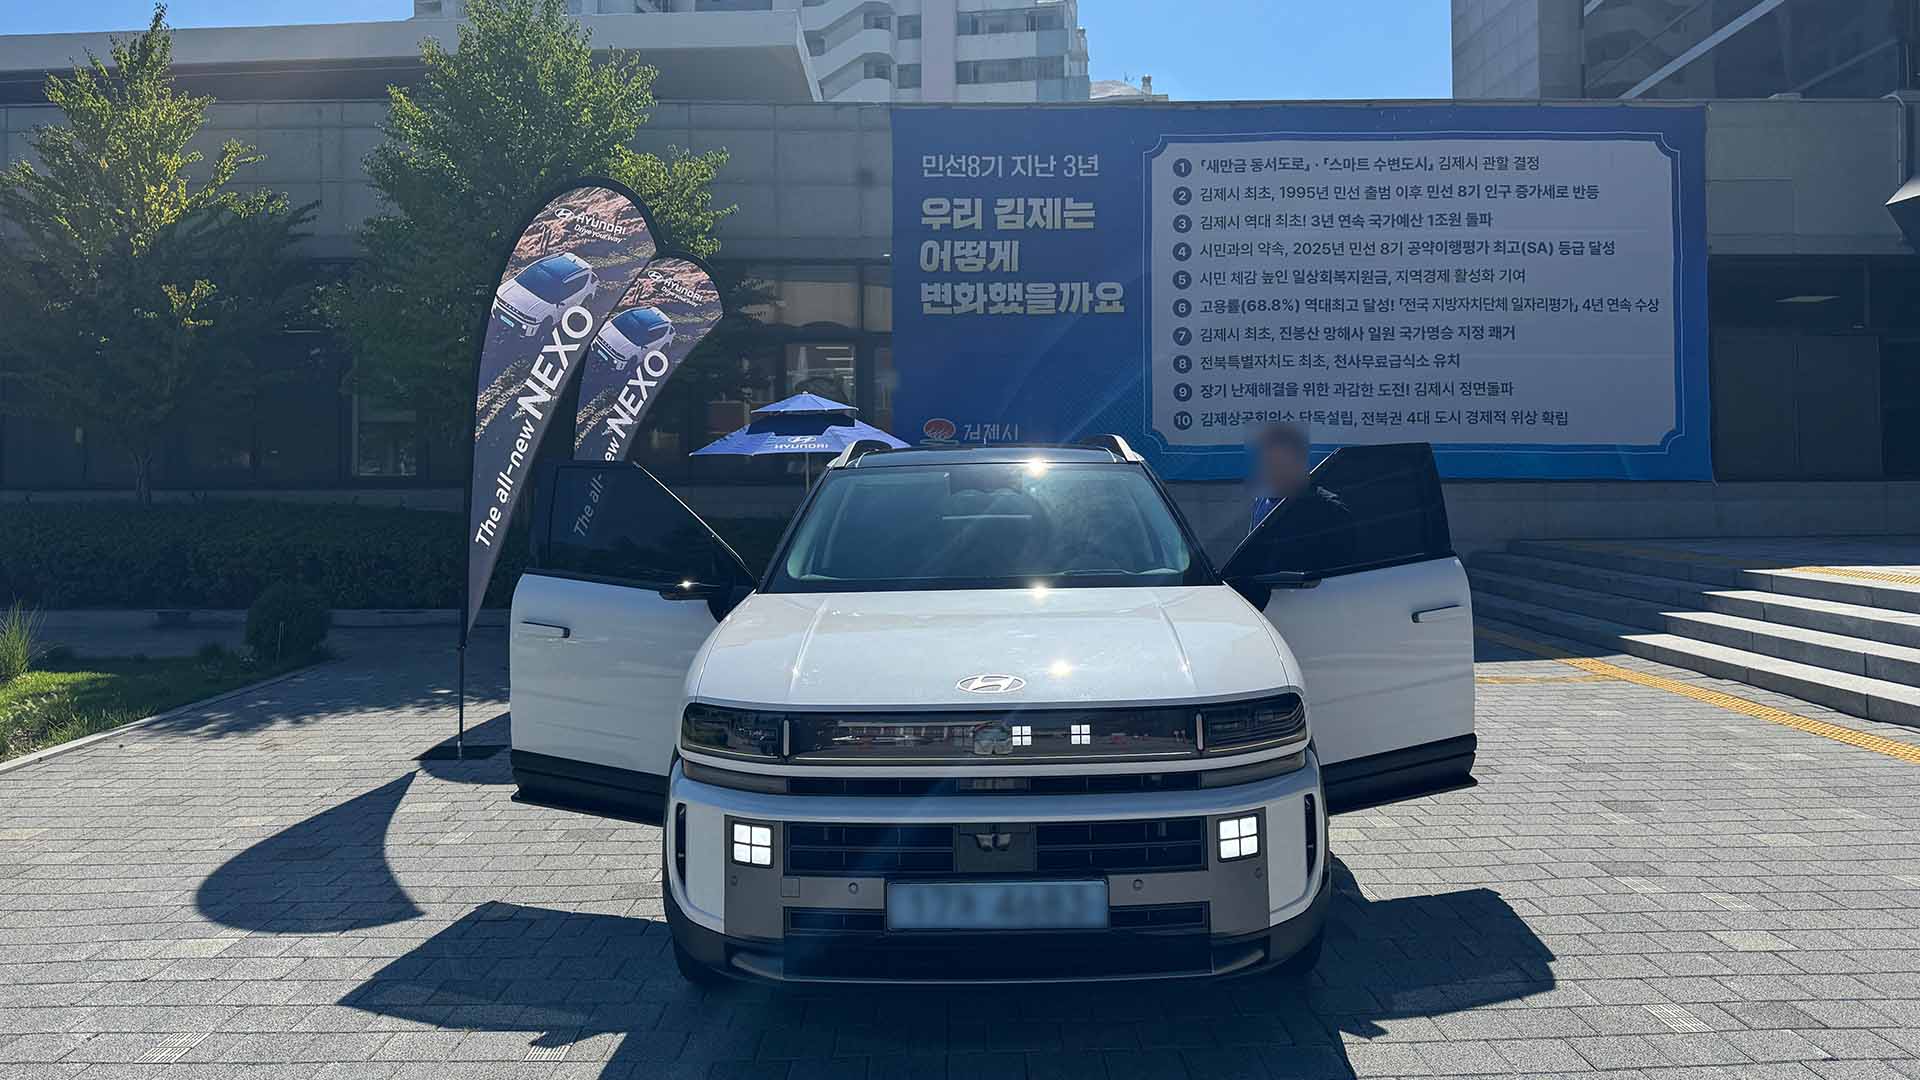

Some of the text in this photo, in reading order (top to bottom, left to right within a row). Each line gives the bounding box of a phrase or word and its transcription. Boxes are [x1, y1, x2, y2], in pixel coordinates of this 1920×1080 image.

[922, 154, 1100, 178] 민선8기 지난 3년
[1439, 156, 1478, 171] 김제시
[1482, 156, 1509, 171] 관할
[1513, 156, 1540, 171] 결정
[1200, 186, 1240, 202] 김제시
[1244, 185, 1275, 202] 최초,
[1279, 185, 1329, 200] 1995년
[1334, 185, 1361, 200] 민선
[1364, 185, 1391, 200] 출범
[1395, 184, 1423, 200] 이후
[1426, 184, 1453, 200] 민선
[1457, 184, 1481, 200] 8기
[1485, 184, 1512, 200] 인구
[1515, 184, 1569, 200] 증가세로
[1572, 184, 1600, 200] 반등
[576, 211, 626, 235] HYUNDAI
[921, 197, 1096, 230] 우리 김제는
[1200, 214, 1240, 230] 김제시
[1244, 214, 1271, 230] 역대
[1275, 213, 1307, 229] 최초!
[1311, 214, 1335, 229] 3년
[1338, 213, 1365, 229] 연속
[1368, 213, 1423, 229] 국가예산
[1427, 213, 1462, 228] 1조원
[1465, 212, 1494, 228] 돌파
[919, 240, 1020, 272] 어떻게
[1200, 242, 1254, 258] 시민과의
[1257, 242, 1289, 258] 약속,
[1293, 241, 1345, 257] 2025년
[1349, 241, 1376, 257] 민선
[1380, 241, 1403, 257] 8기
[1407, 240, 1490, 256] 공약이행평가
[1493, 240, 1554, 257] 최고(SA)
[1558, 240, 1586, 256] 등급
[1589, 240, 1616, 256] 달성
[1200, 271, 1226, 286] 시민
[1230, 270, 1257, 286] 체감
[1261, 270, 1288, 286] 높인
[1292, 269, 1393, 287] 일상회복지원금,
[1396, 268, 1450, 285] 지역경제
[1454, 268, 1495, 284] 활성화
[1499, 268, 1526, 285] 기여
[920, 281, 1125, 315] 변화했을까요
[1200, 298, 1300, 315] 고용률(68.8%)
[1305, 298, 1359, 313] 역대최고
[1363, 298, 1395, 313] 달성!
[1432, 296, 1509, 312] 지방자치단체
[1582, 297, 1604, 313] 4년
[1607, 297, 1633, 313] 연속
[1635, 297, 1660, 313] 수상
[1200, 327, 1240, 343] 김제시
[1244, 326, 1275, 342] 최초,
[1279, 326, 1320, 342] 진봉산
[1323, 326, 1365, 342] 망해사
[1368, 326, 1396, 342] 일원
[1400, 325, 1455, 341] 국가명승
[1458, 325, 1485, 341] 지정
[1200, 355, 1296, 371] 전북특별자치도
[1299, 354, 1330, 371] 최초,
[1334, 354, 1430, 370] 천사무료급식소
[1433, 353, 1460, 369] 유치
[1201, 383, 1227, 399] 장기
[1231, 382, 1298, 398] 난제해결을
[1302, 382, 1329, 398] 위한
[1333, 382, 1374, 398] 과감한
[1377, 382, 1410, 397] 도전!
[1415, 381, 1455, 397] 김제시
[1459, 381, 1514, 397] 정면돌파
[475, 305, 593, 547] The all-new NEXO
[1361, 410, 1402, 427] 전북권
[1406, 411, 1430, 426] 4대
[1434, 410, 1461, 425] 도시
[1465, 410, 1508, 426] 경제적
[1511, 410, 1538, 426] 위상
[1542, 410, 1569, 427] 확립
[574, 504, 595, 537] The
[604, 349, 669, 440] NEXO
